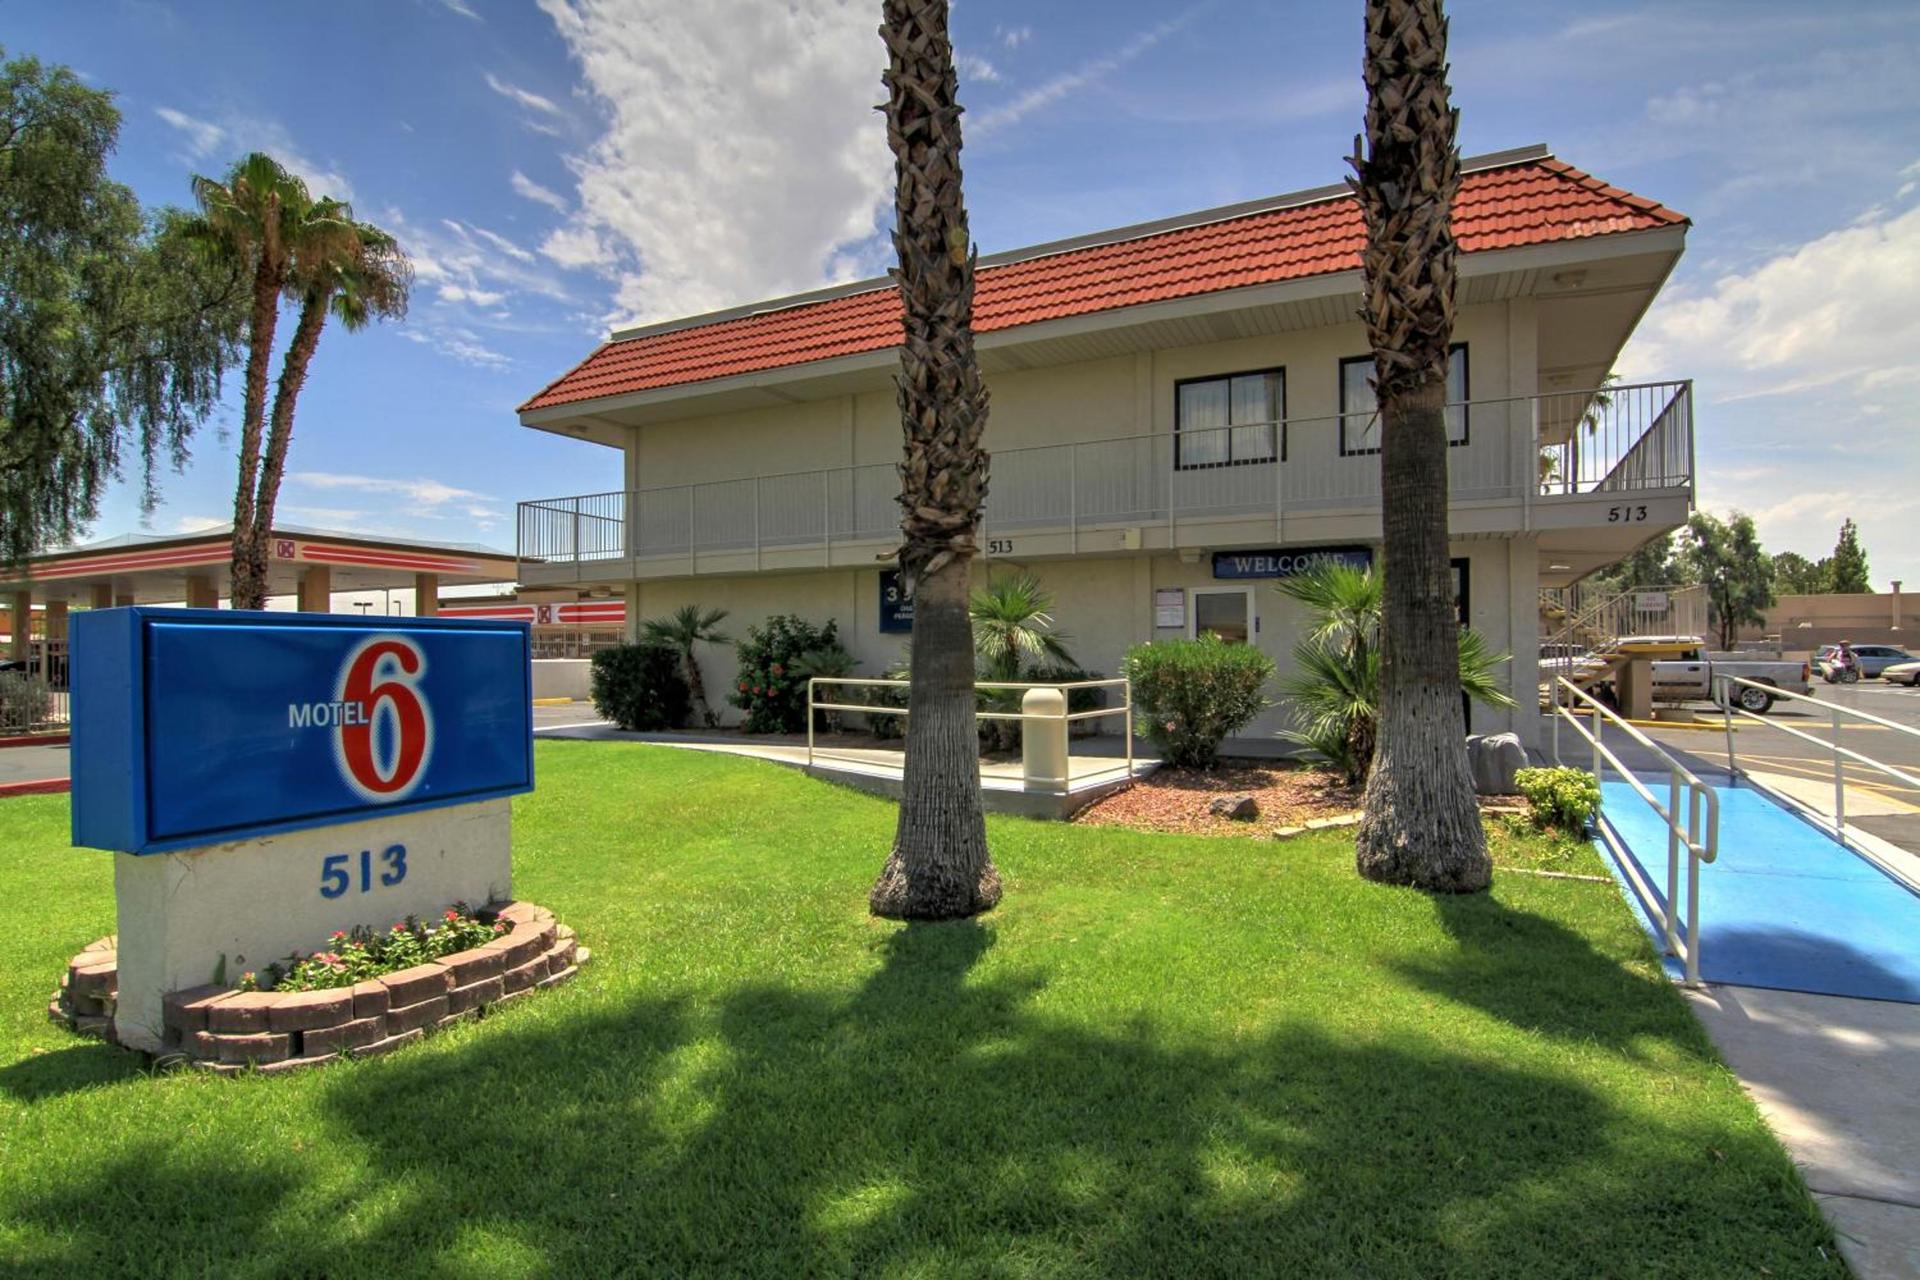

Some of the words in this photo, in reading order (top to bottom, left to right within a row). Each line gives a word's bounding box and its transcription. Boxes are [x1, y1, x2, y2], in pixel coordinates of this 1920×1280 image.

[1608, 505, 1647, 522] 513
[989, 540, 1013, 554] 513
[288, 701, 370, 728] MOTEL
[338, 638, 430, 797] 6
[319, 843, 408, 901] 513
